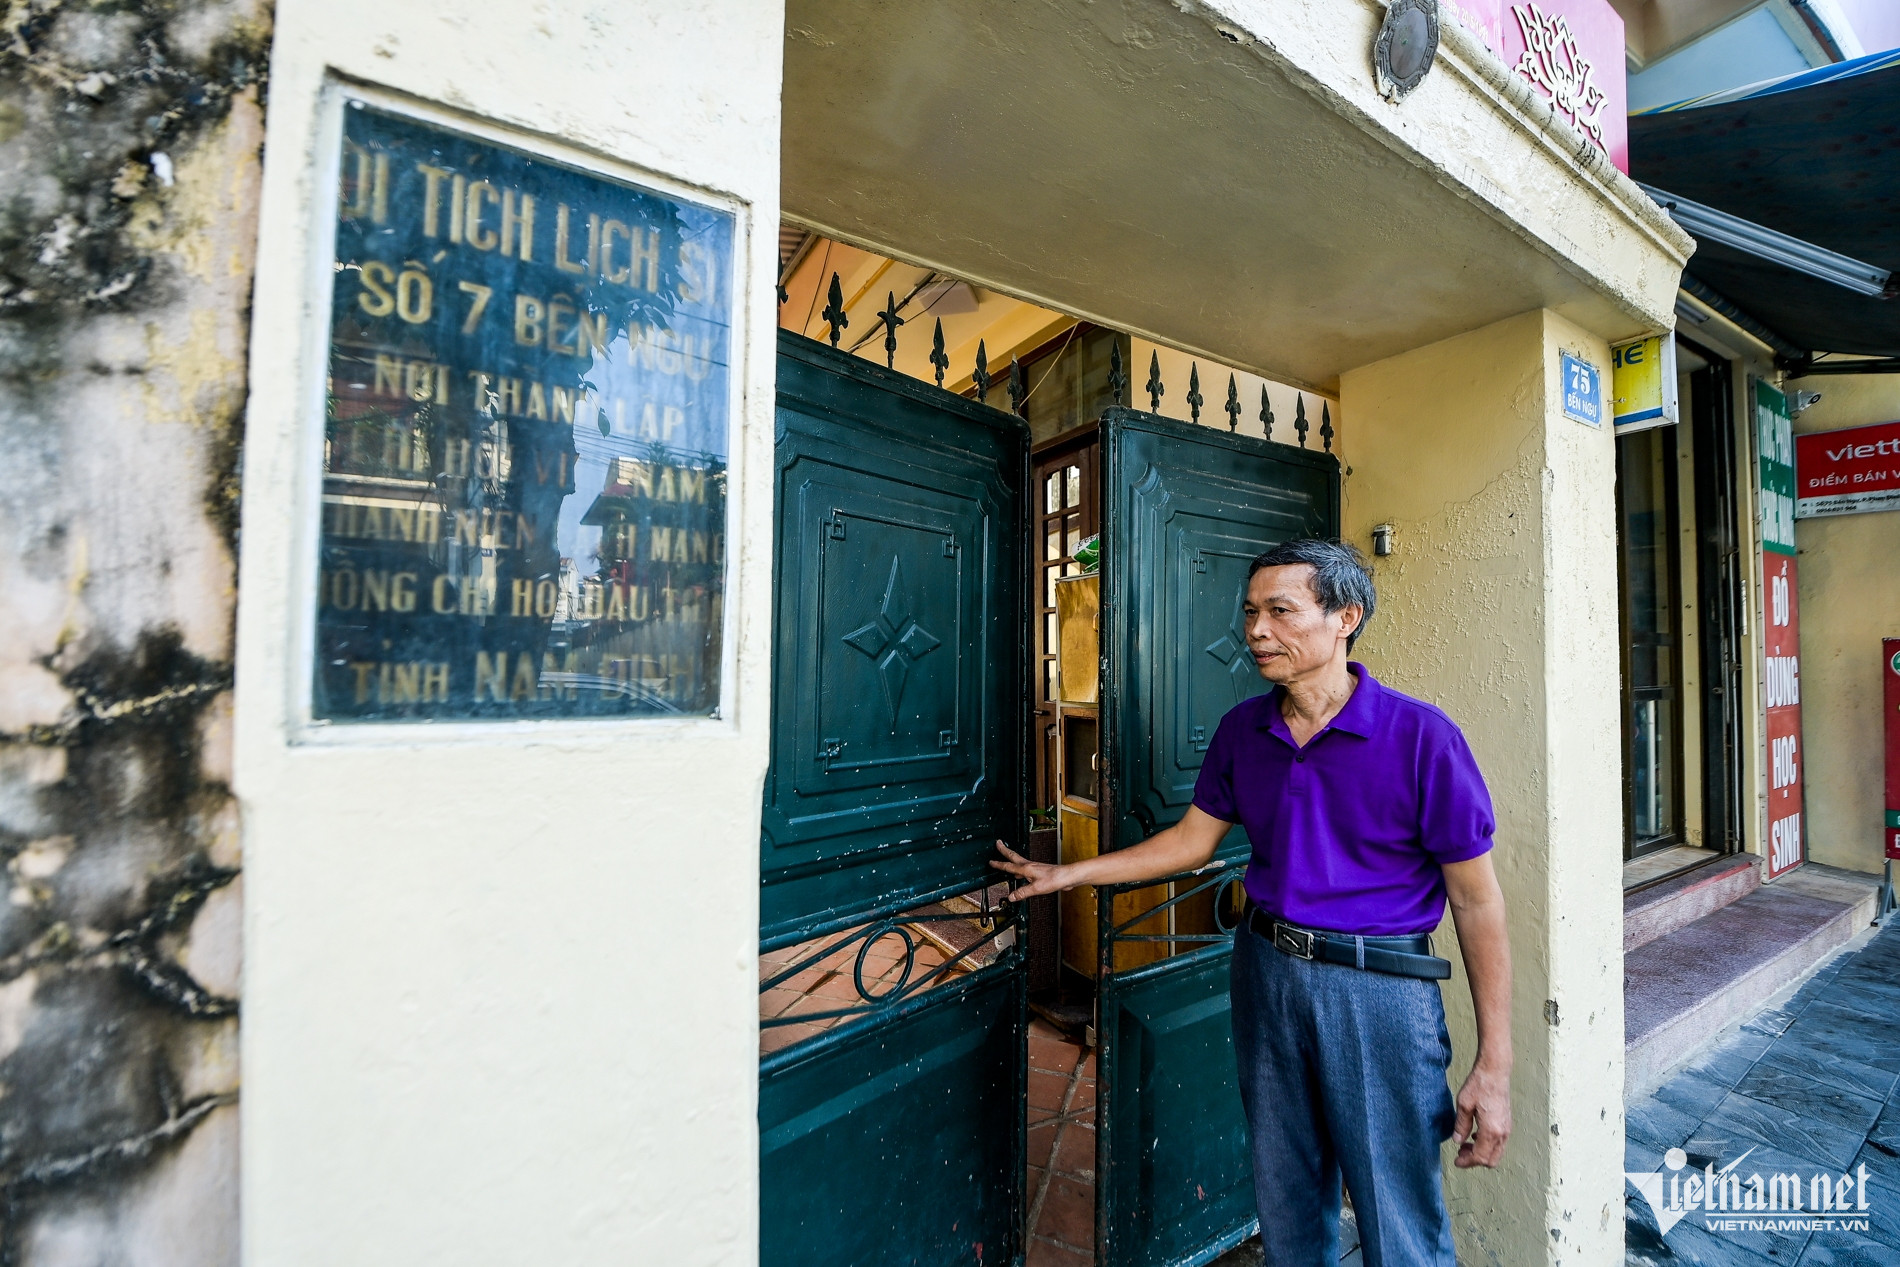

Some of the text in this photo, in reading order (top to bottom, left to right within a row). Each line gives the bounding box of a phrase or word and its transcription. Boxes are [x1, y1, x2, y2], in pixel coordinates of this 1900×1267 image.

[416, 153, 535, 262] TÍCH
[357, 249, 447, 325] SỐ
[458, 279, 493, 335] 7
[1570, 362, 1591, 395] 75
[632, 464, 707, 505] NAM
[1853, 470, 1887, 483] BÁN
[1766, 645, 1800, 708] DÙNG
[1772, 734, 1797, 799] HỌC
[1772, 812, 1800, 873] SINH
